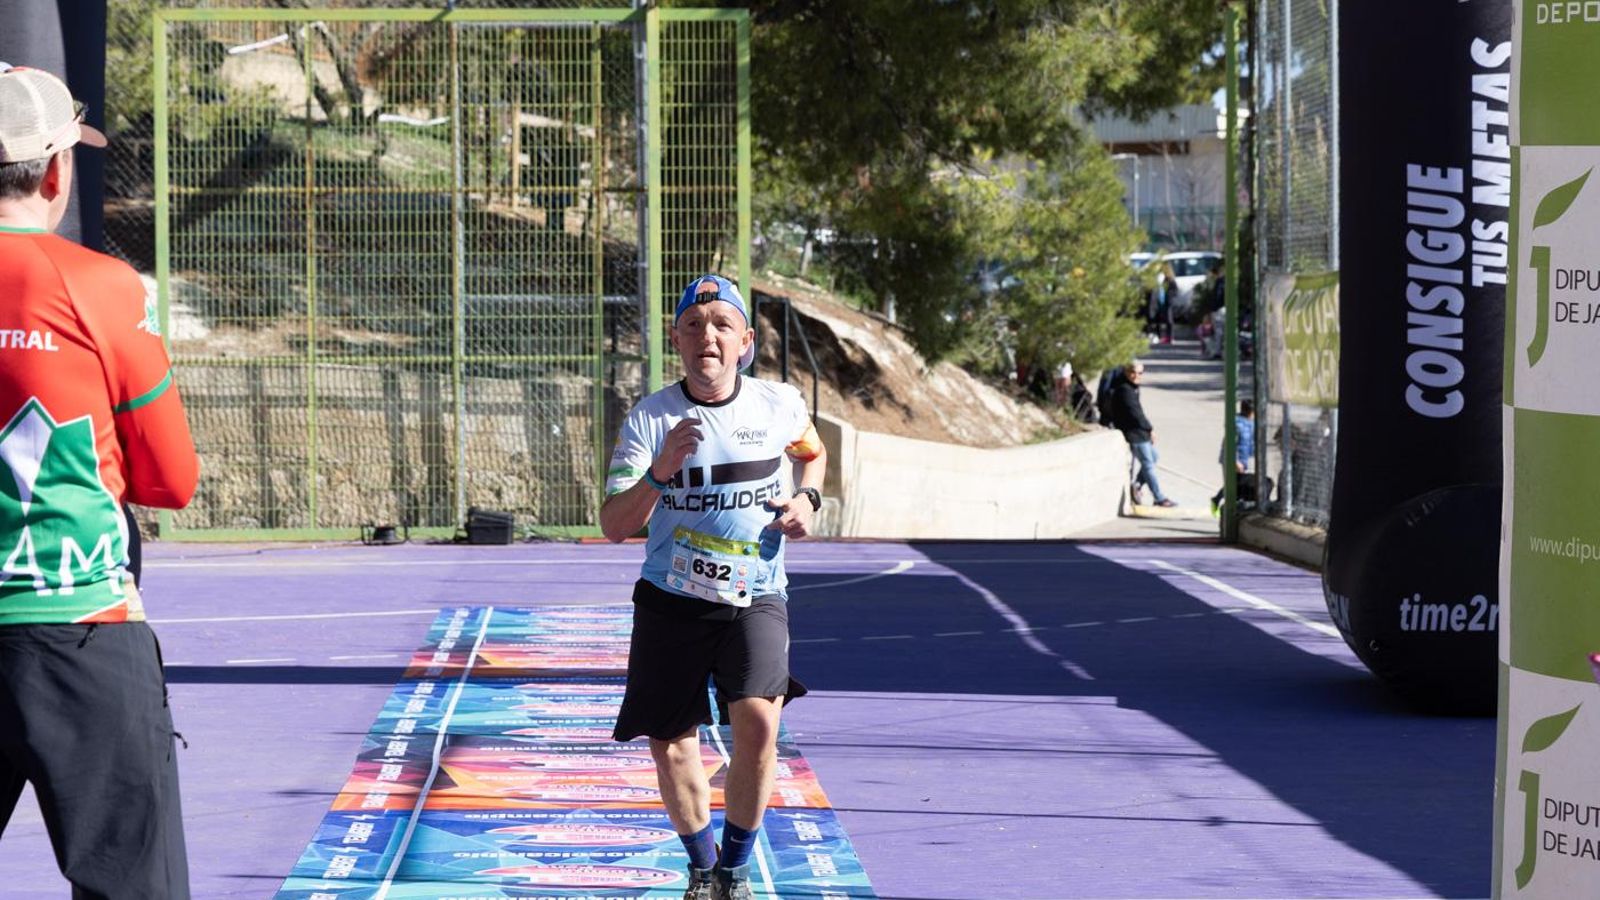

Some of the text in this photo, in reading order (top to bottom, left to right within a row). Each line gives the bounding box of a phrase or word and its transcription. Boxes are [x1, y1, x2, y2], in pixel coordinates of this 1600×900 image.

[1536, 1, 1600, 24] DEPO
[1470, 37, 1512, 287] TUS METAS
[1405, 163, 1465, 419] CONSIGUE
[1555, 268, 1600, 291] DIPU
[1555, 302, 1579, 323] DE
[0, 329, 58, 351] TRAL
[1529, 536, 1600, 563] www.dipu
[692, 558, 732, 582] 632
[1400, 593, 1500, 632] time2r
[1544, 797, 1600, 829] DIPUT
[1543, 830, 1567, 855] DE
